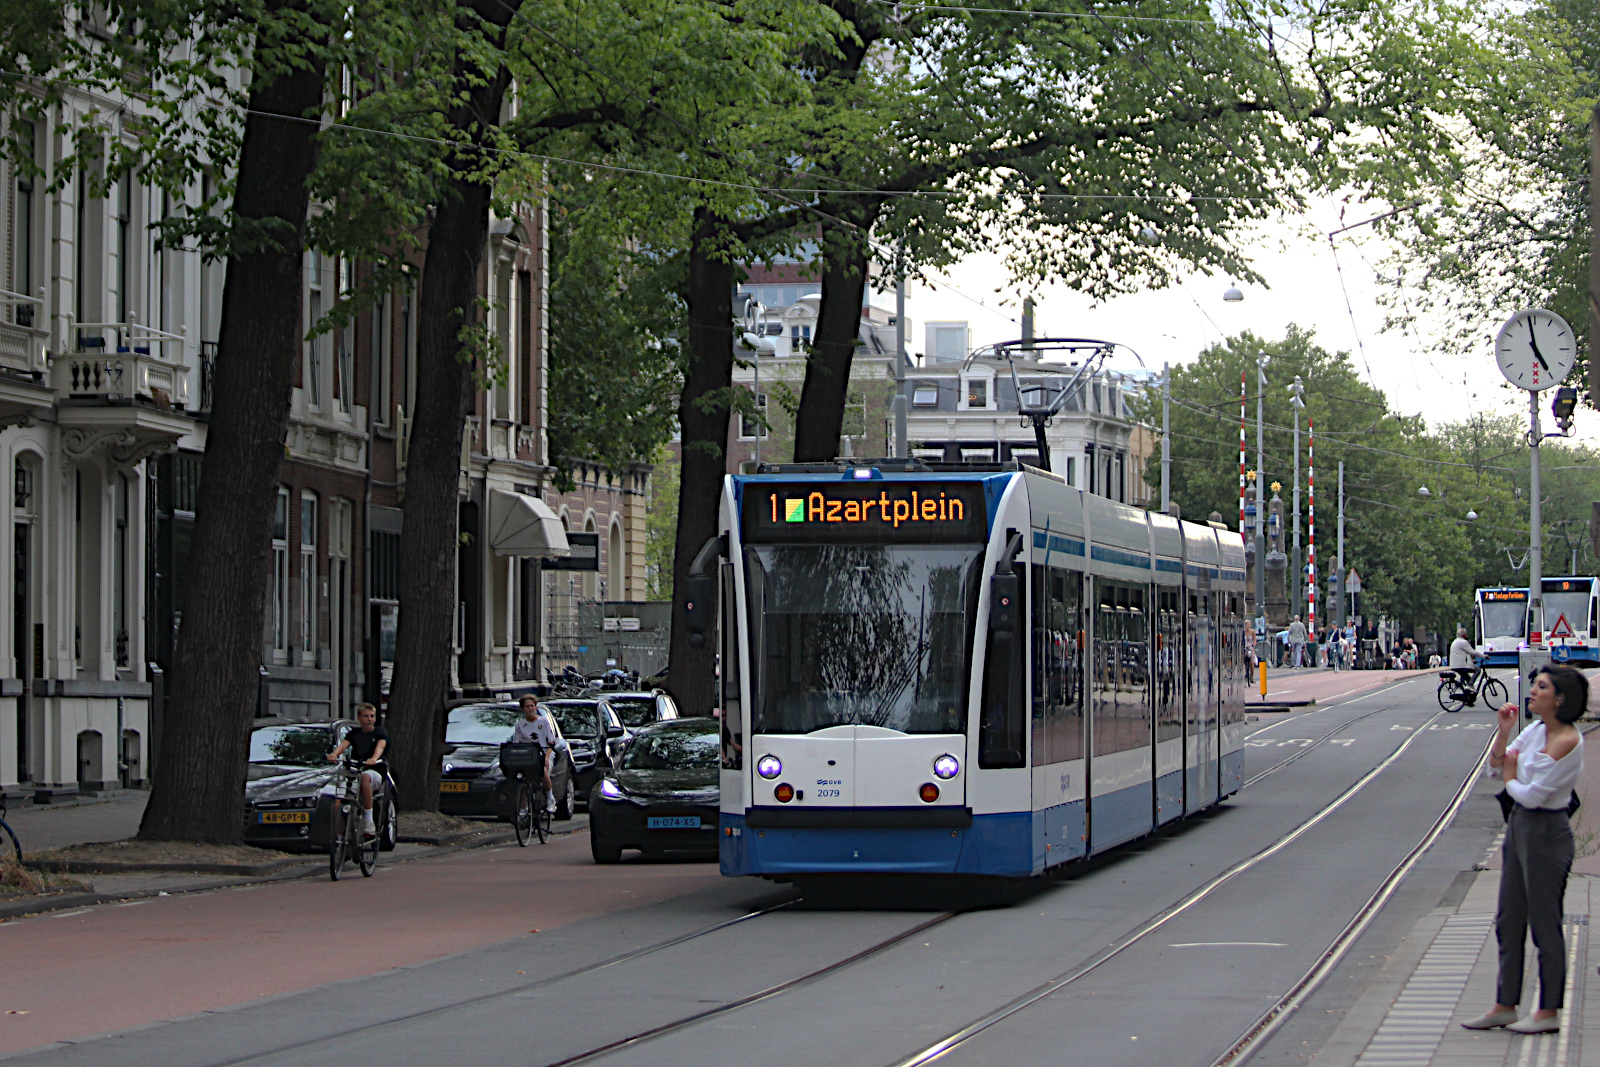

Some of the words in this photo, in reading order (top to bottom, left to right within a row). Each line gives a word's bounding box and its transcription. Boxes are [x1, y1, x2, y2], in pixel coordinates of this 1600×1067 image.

[770, 493, 778, 523] 1
[808, 491, 964, 528] Azartplein
[1562, 581, 1570, 591] 19
[817, 789, 840, 797] 2079
[265, 813, 306, 822] 48-GPT-8
[653, 818, 696, 827] H-074-XS
